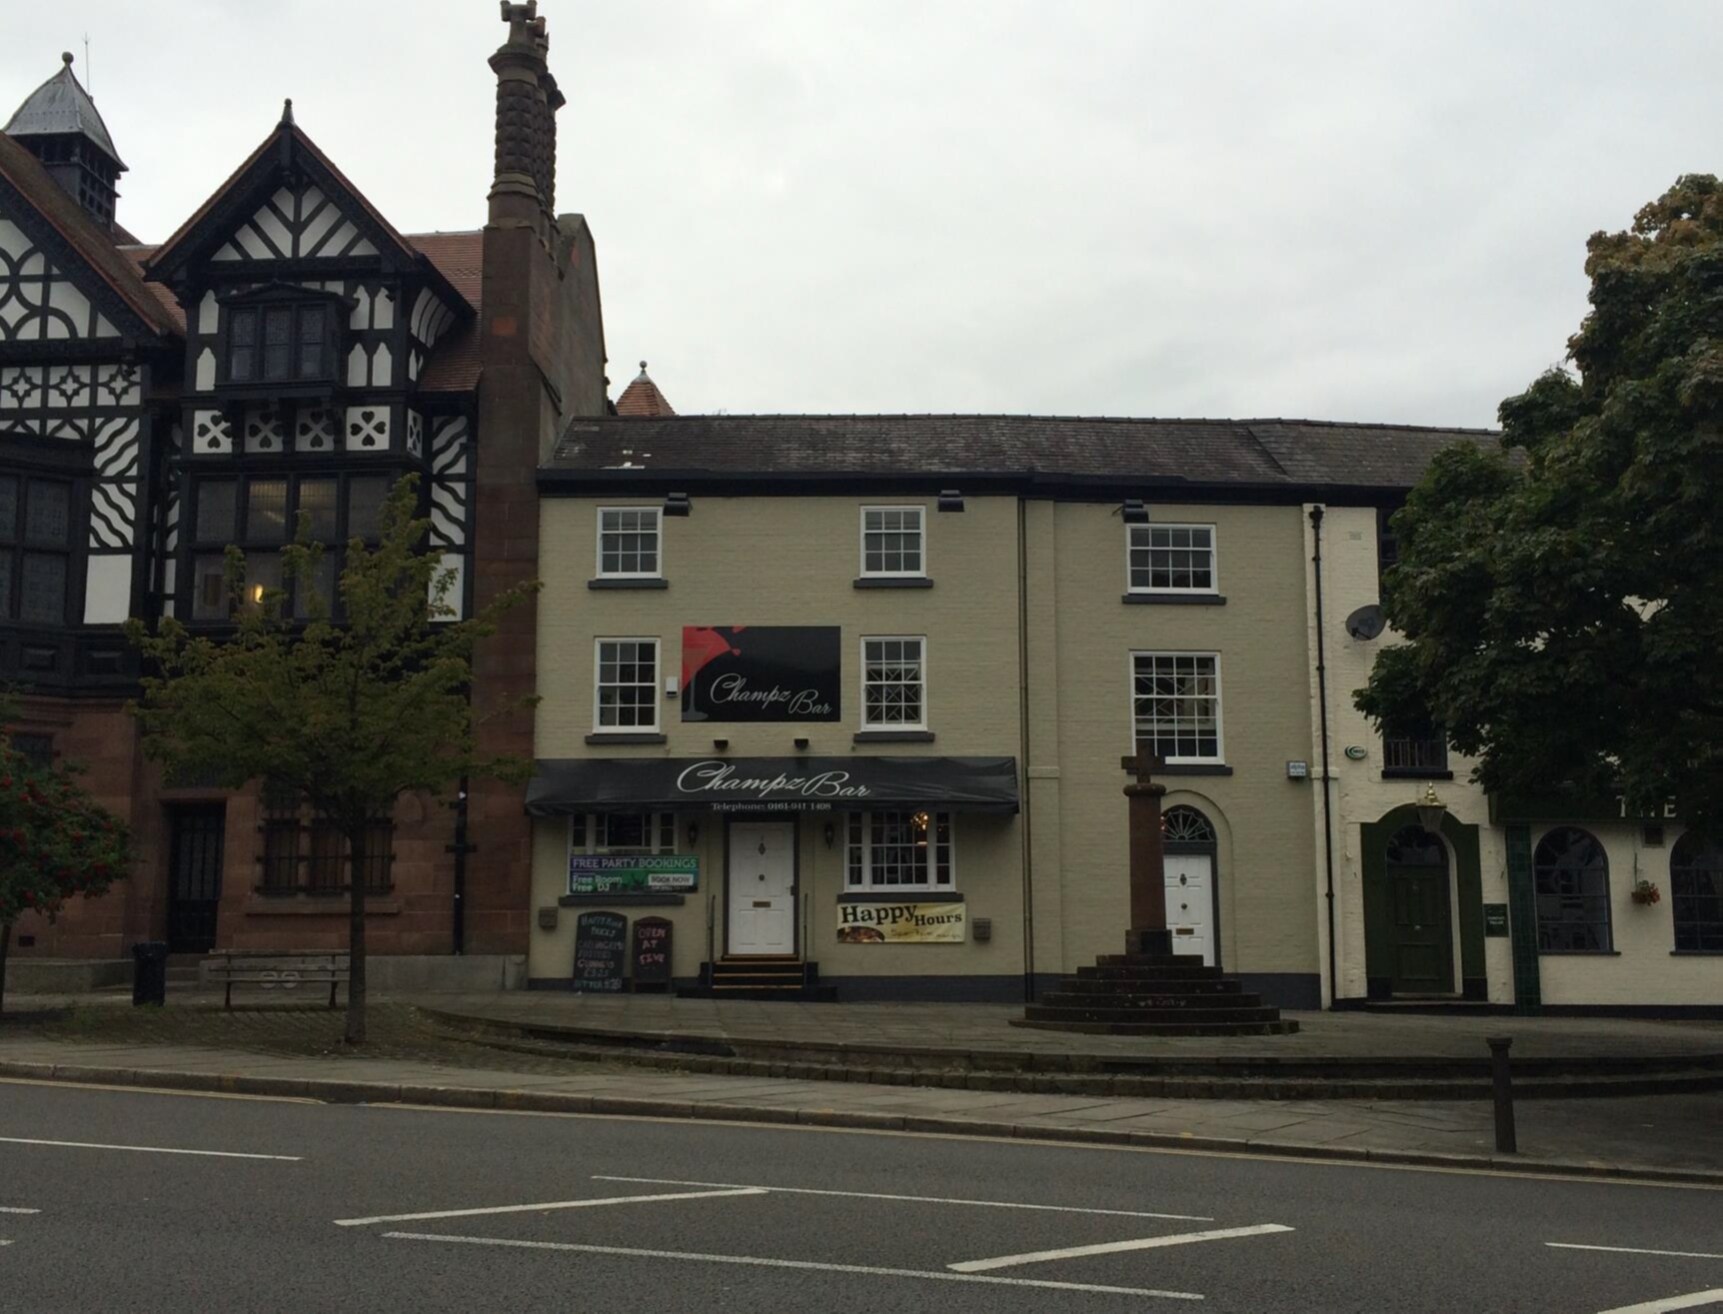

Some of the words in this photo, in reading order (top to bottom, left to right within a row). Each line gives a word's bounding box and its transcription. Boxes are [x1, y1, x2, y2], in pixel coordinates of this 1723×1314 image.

[710, 673, 791, 709] Champz
[788, 689, 832, 714] Bar
[677, 760, 806, 798] Champz
[801, 771, 871, 797] Bar
[573, 858, 599, 868] FREE
[602, 858, 637, 868] PARTY
[638, 858, 697, 869] BOOKINGS
[573, 873, 593, 883] Free
[595, 875, 622, 884] Room
[573, 883, 593, 891] Free
[841, 904, 918, 925] Happy
[914, 913, 962, 926] Hours
[642, 939, 658, 950] AT
